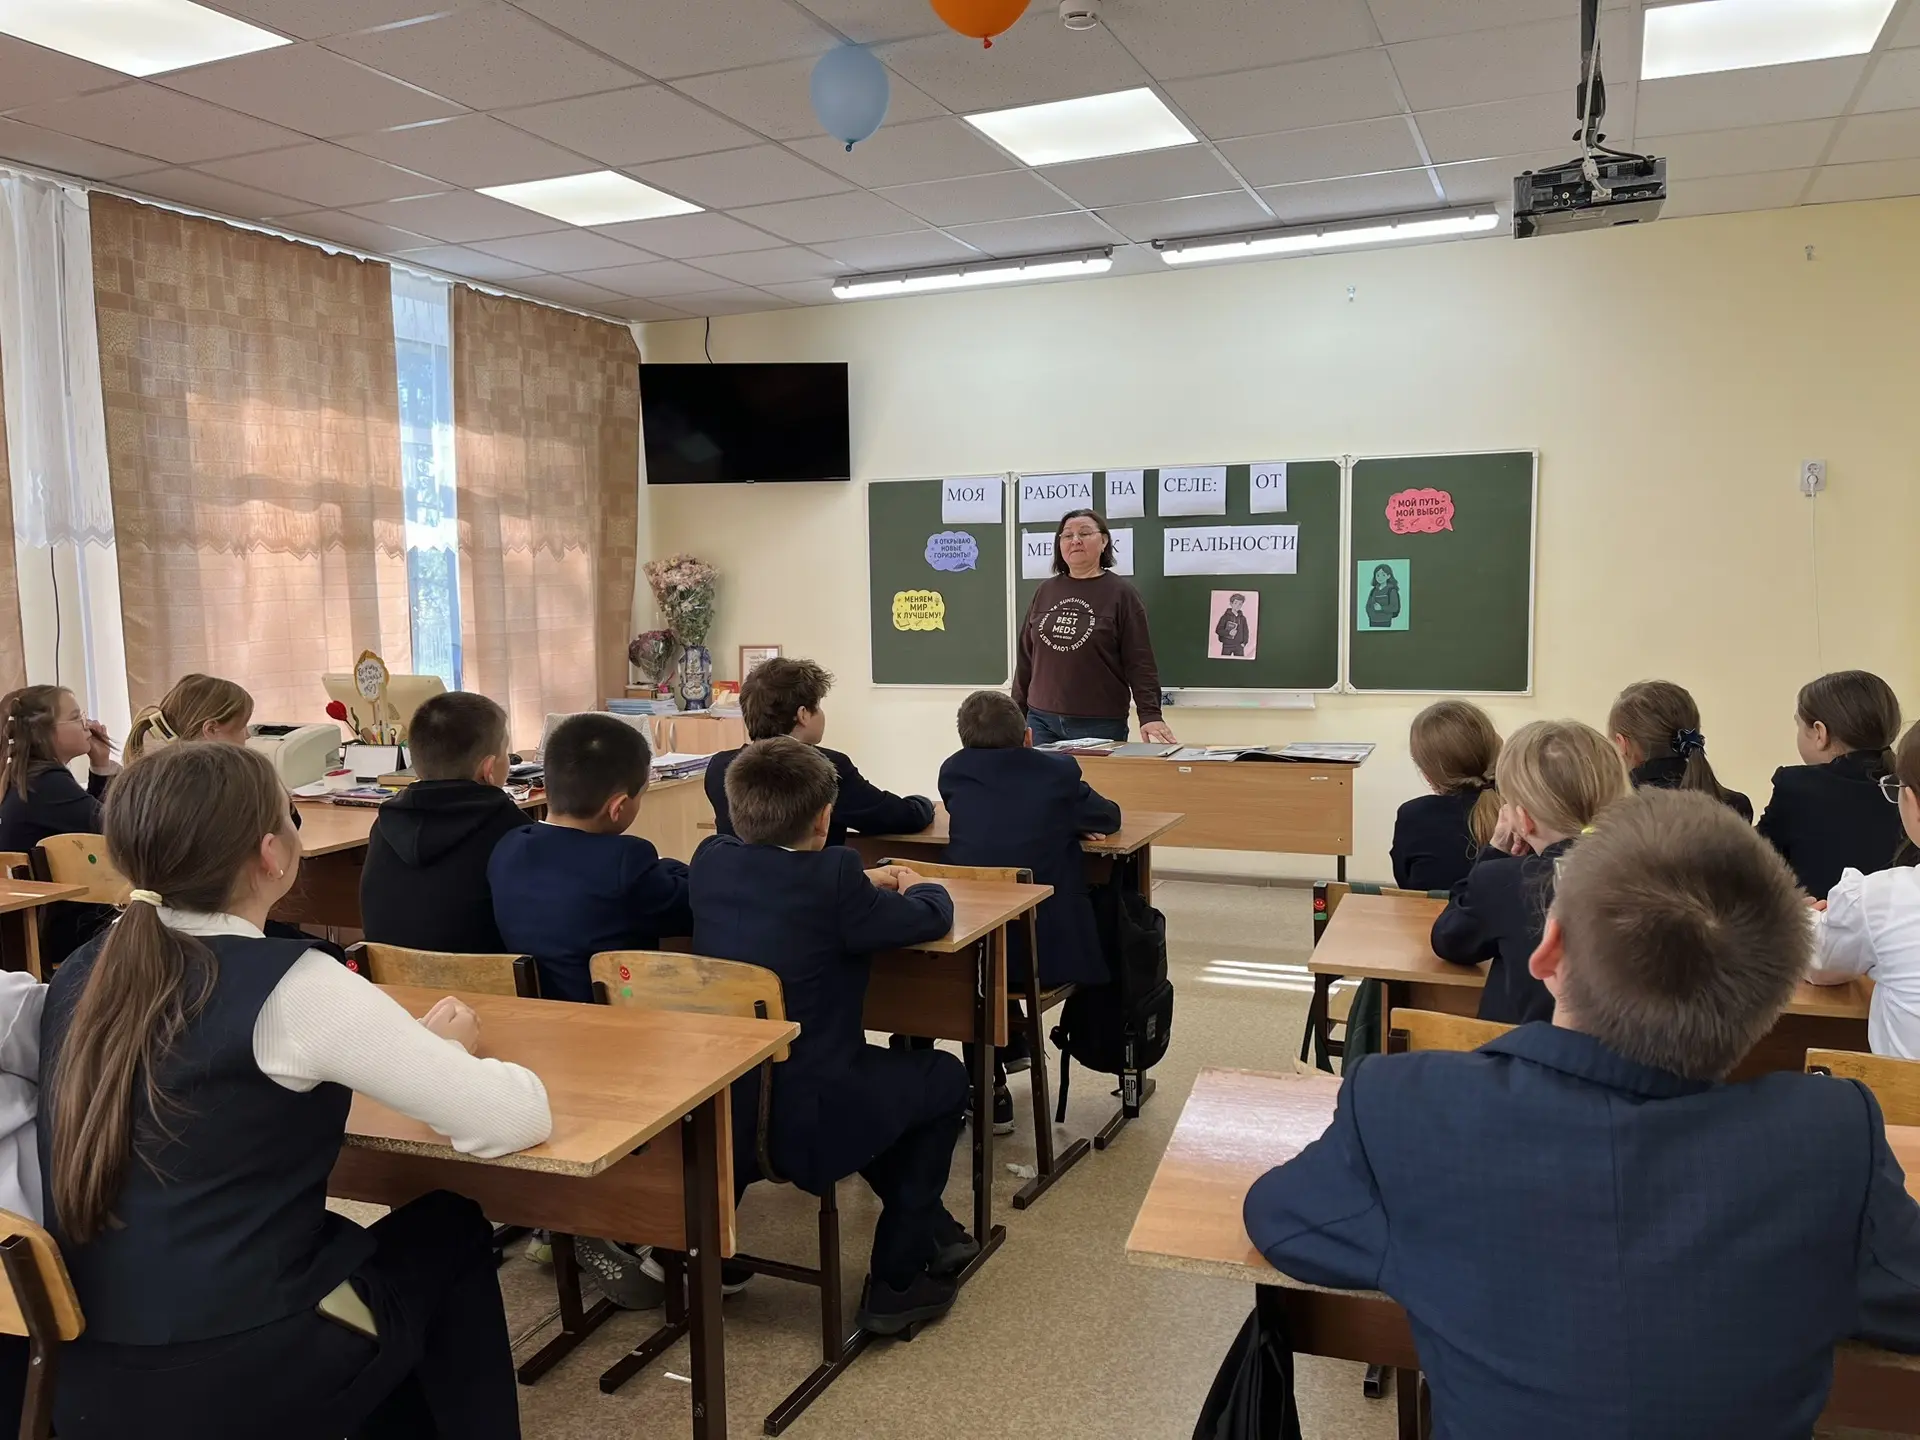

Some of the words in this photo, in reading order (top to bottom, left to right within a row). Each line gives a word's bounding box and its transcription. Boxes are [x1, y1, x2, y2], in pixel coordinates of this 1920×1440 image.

[947, 487, 985, 502] МОЯ
[1024, 483, 1091, 500] РАБОТА
[1111, 480, 1136, 495] НА
[1163, 477, 1217, 492] СЕЛЕ:
[1255, 473, 1282, 489] ОТ
[1398, 497, 1417, 507] МОЙ
[1419, 498, 1440, 506] ПУТЬ
[1396, 507, 1415, 517] МОЙ
[1417, 507, 1447, 516] ВЫБОР!
[1169, 535, 1296, 552] РЕАЛЬНОСТИ
[1056, 616, 1079, 626] BEST
[1052, 625, 1077, 635] MEDS
